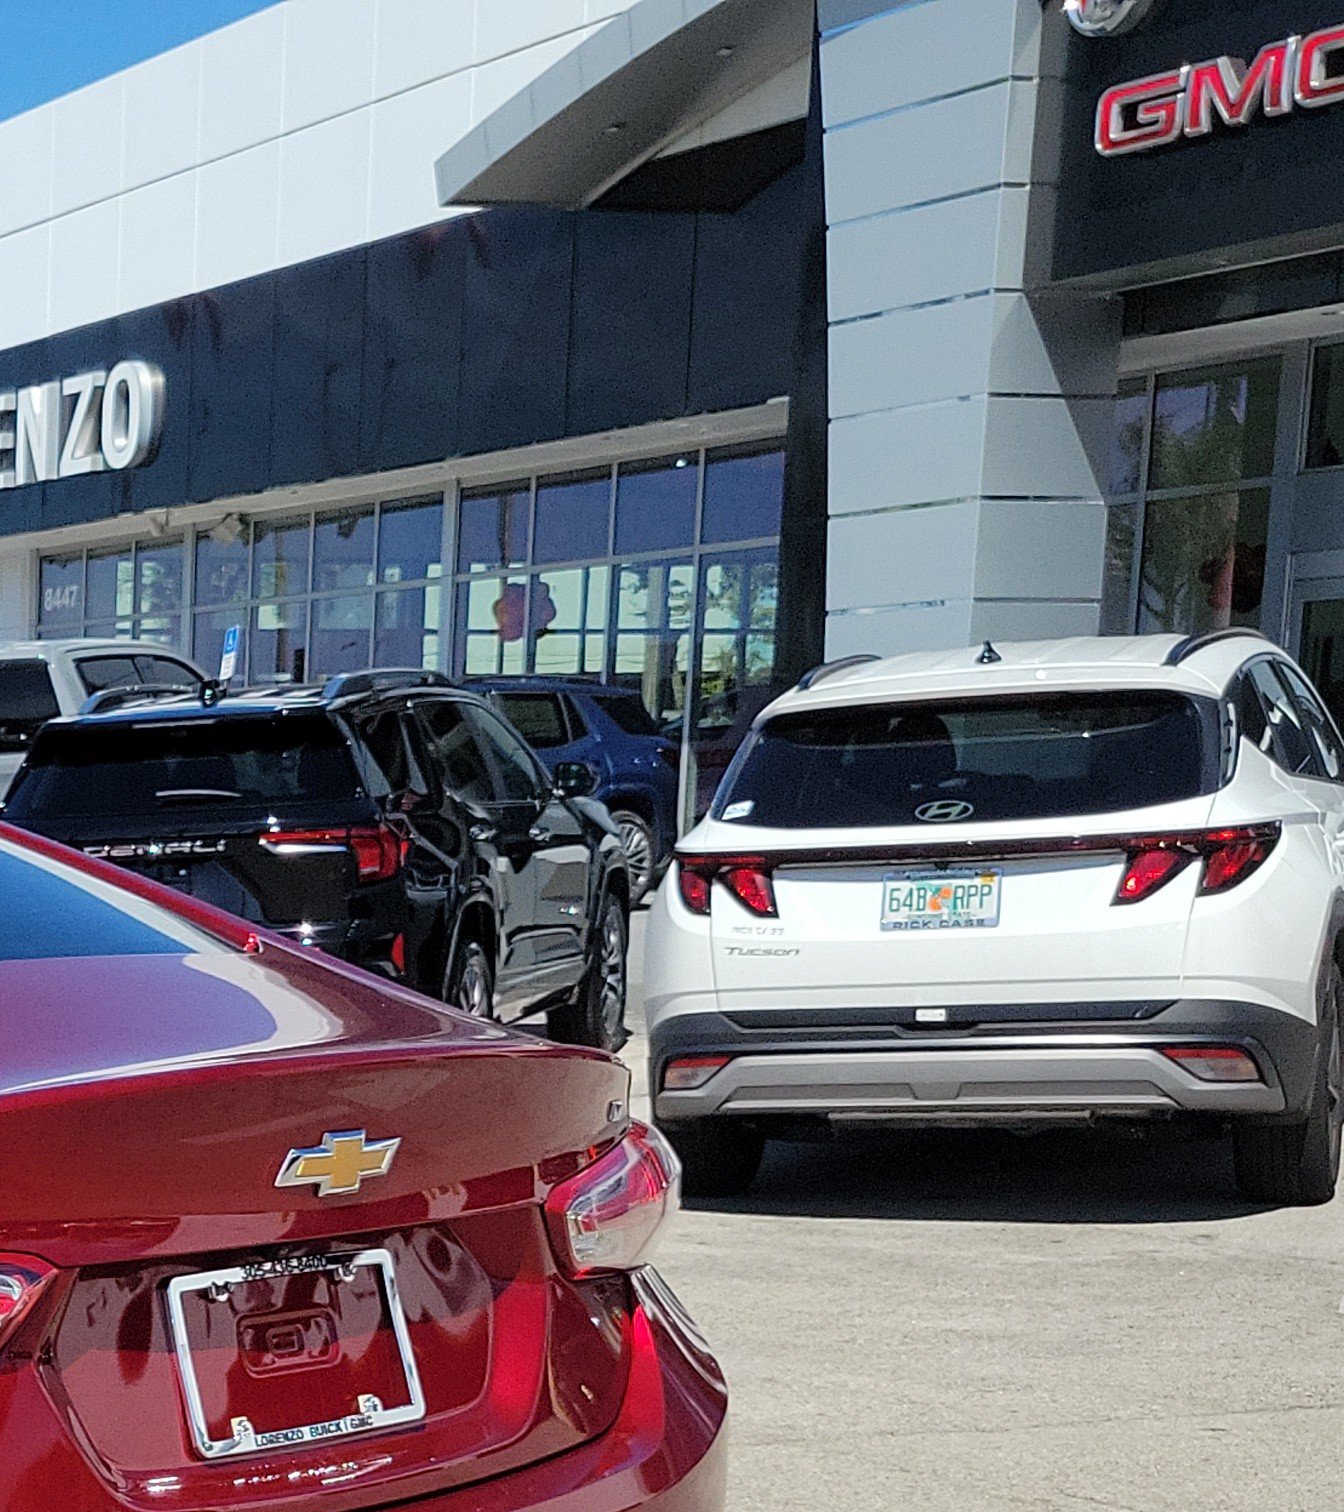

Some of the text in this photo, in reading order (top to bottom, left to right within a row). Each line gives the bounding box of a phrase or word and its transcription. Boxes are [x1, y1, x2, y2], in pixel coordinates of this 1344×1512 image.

[889, 884, 992, 912] 64B RPP
[892, 918, 987, 930] RICK CASE
[254, 1428, 305, 1448] LORENZO
